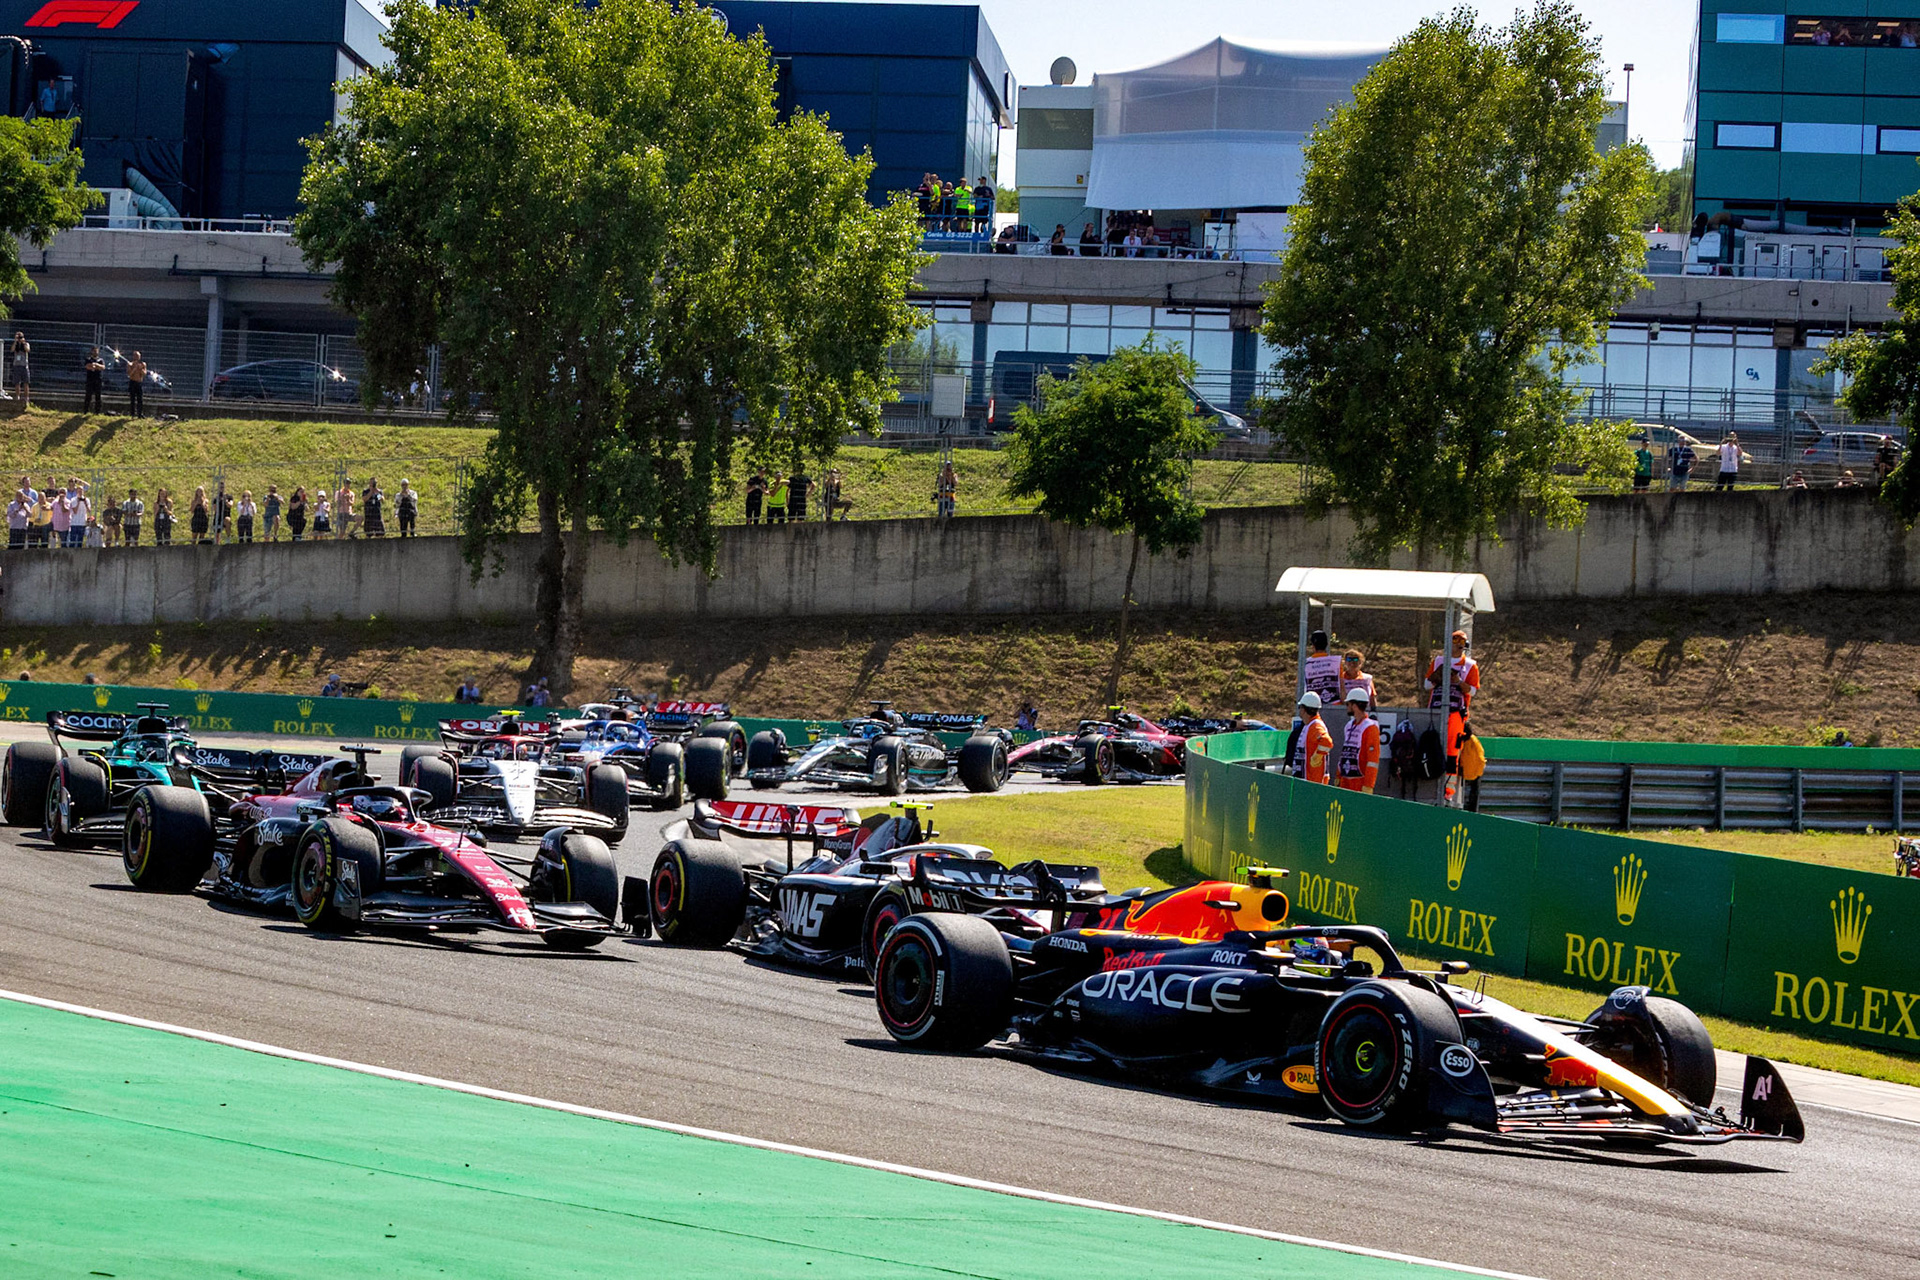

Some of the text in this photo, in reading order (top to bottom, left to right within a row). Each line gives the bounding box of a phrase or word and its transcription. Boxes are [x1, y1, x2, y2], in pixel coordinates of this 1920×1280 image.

[24, 0, 140, 29] F1
[182, 715, 233, 730] OLEX
[274, 720, 336, 737] ROLEX
[374, 725, 437, 741] ROLEX
[461, 720, 540, 733] ORN
[195, 749, 231, 767] Stake
[279, 755, 314, 771] Stake
[258, 820, 284, 846] Stake
[323, 836, 332, 877] ZERO
[908, 886, 949, 911] Mobil
[1297, 871, 1360, 924] ROLEX
[774, 888, 837, 938] HAAS
[1407, 898, 1497, 957] ROLEX
[1048, 936, 1089, 953] HONDA
[1211, 949, 1247, 966] ROKT
[1563, 932, 1682, 995] ROLEX
[1082, 970, 1251, 1013] ORACLE
[1771, 971, 1920, 1040] ROLEX
[1394, 1013, 1413, 1090] P ZERO
[1297, 1072, 1316, 1085] RAU
